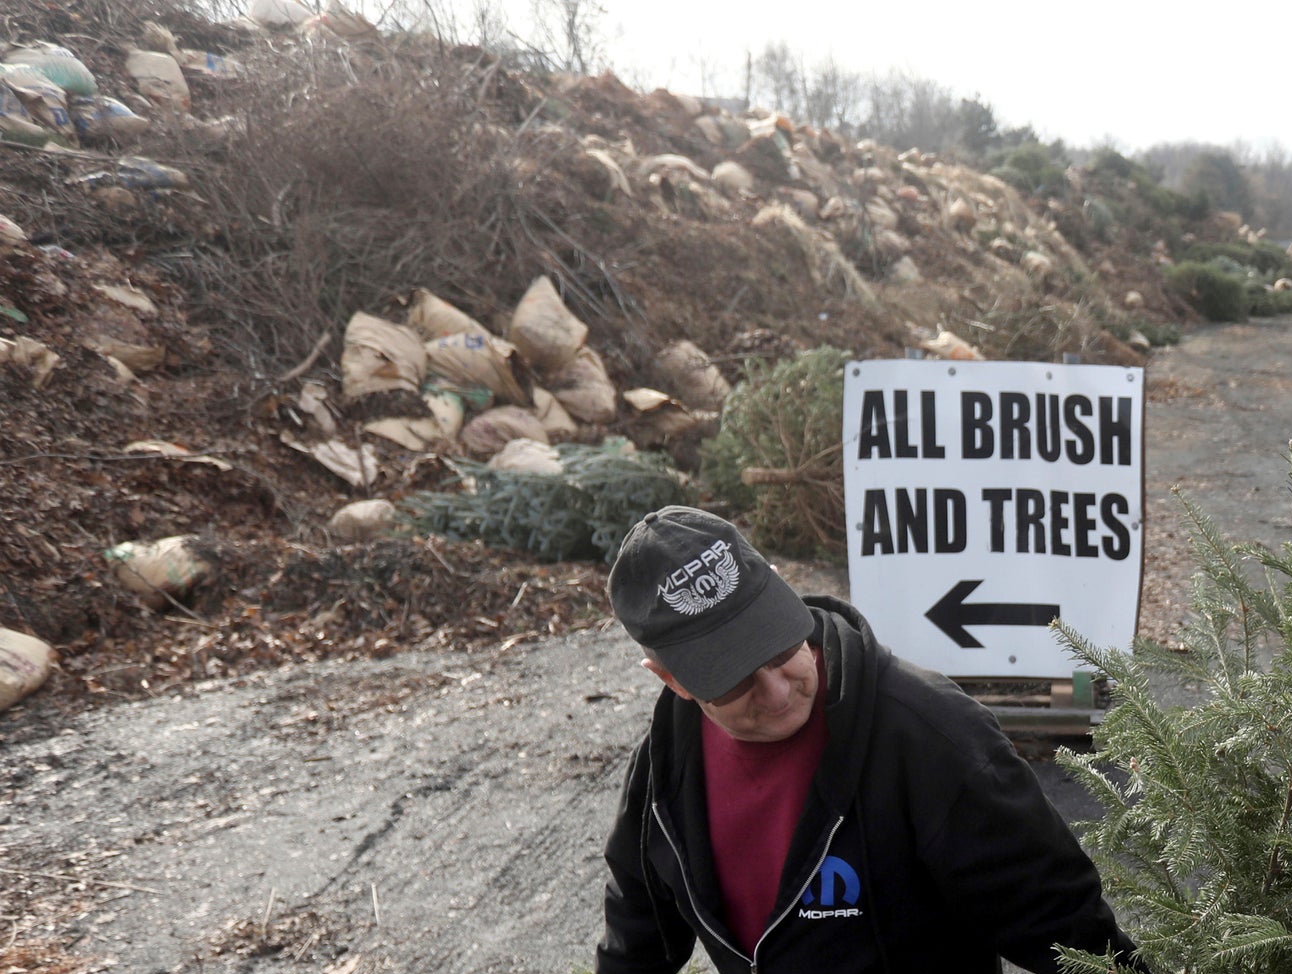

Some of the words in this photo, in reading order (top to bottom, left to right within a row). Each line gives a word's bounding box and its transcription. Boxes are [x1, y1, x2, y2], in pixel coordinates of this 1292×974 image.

[858, 390, 945, 460] ALL
[960, 390, 1132, 466] BRUSH
[861, 488, 968, 557] AND
[982, 488, 1130, 561] TREES
[657, 539, 731, 596] MOPAR
[798, 908, 859, 919] MOPAR
